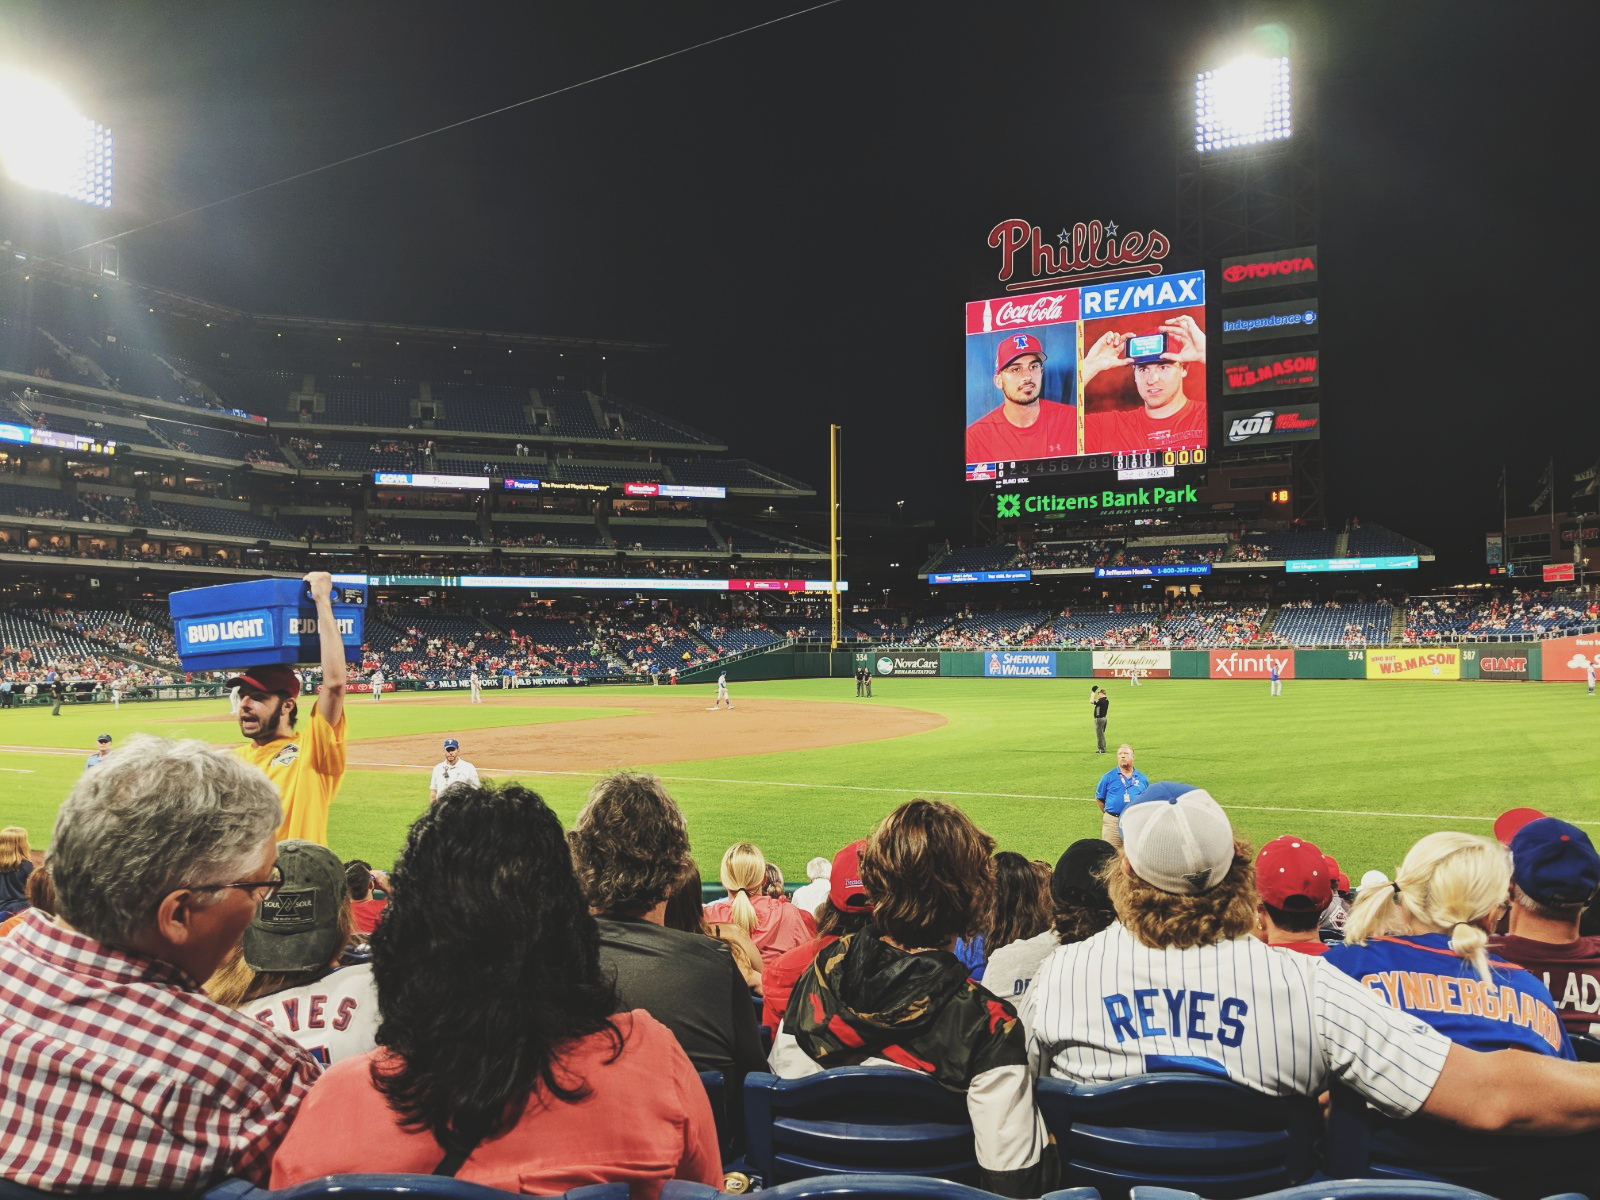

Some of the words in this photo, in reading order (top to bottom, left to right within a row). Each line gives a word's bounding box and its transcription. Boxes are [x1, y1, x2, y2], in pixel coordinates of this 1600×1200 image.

[988, 218, 1170, 282] Phillies
[1245, 257, 1315, 278] TOYOTA
[996, 294, 1067, 326] Coca-Cola
[1223, 314, 1301, 331] Independence
[1165, 451, 1174, 465] 0
[1179, 450, 1188, 464] 0
[1194, 449, 1203, 463] 0
[1021, 463, 1029, 474] 3
[1036, 462, 1044, 472] 4
[1049, 461, 1056, 472] 5
[1061, 460, 1069, 471] 6
[1077, 459, 1084, 470] 7
[1089, 458, 1097, 469] 8
[1102, 457, 1110, 468] 9
[571, 483, 589, 491] Physical
[1024, 493, 1098, 512] Citizens
[1102, 488, 1149, 507] Bank
[1154, 484, 1197, 504] Park
[1158, 566, 1207, 575] 1-800-JEFF-NOW
[188, 623, 219, 643] BUD
[220, 618, 264, 640] LIGHT
[289, 618, 317, 634] BUD
[856, 653, 868, 661] 334
[894, 658, 938, 669] NovaCare
[1002, 653, 1049, 664] SHERWIN
[1103, 651, 1160, 667] Yuengling
[1348, 651, 1364, 661] 374
[1462, 651, 1475, 660] 387
[1215, 652, 1289, 676] xfinity
[1480, 656, 1527, 673] GIANT
[440, 680, 458, 688] MLB
[533, 677, 569, 685] NETWORK
[264, 901, 280, 909] SOUL
[295, 899, 312, 908] SOUL
[1103, 988, 1248, 1048] REYES
[1361, 970, 1562, 1051] SYNDERGAARD
